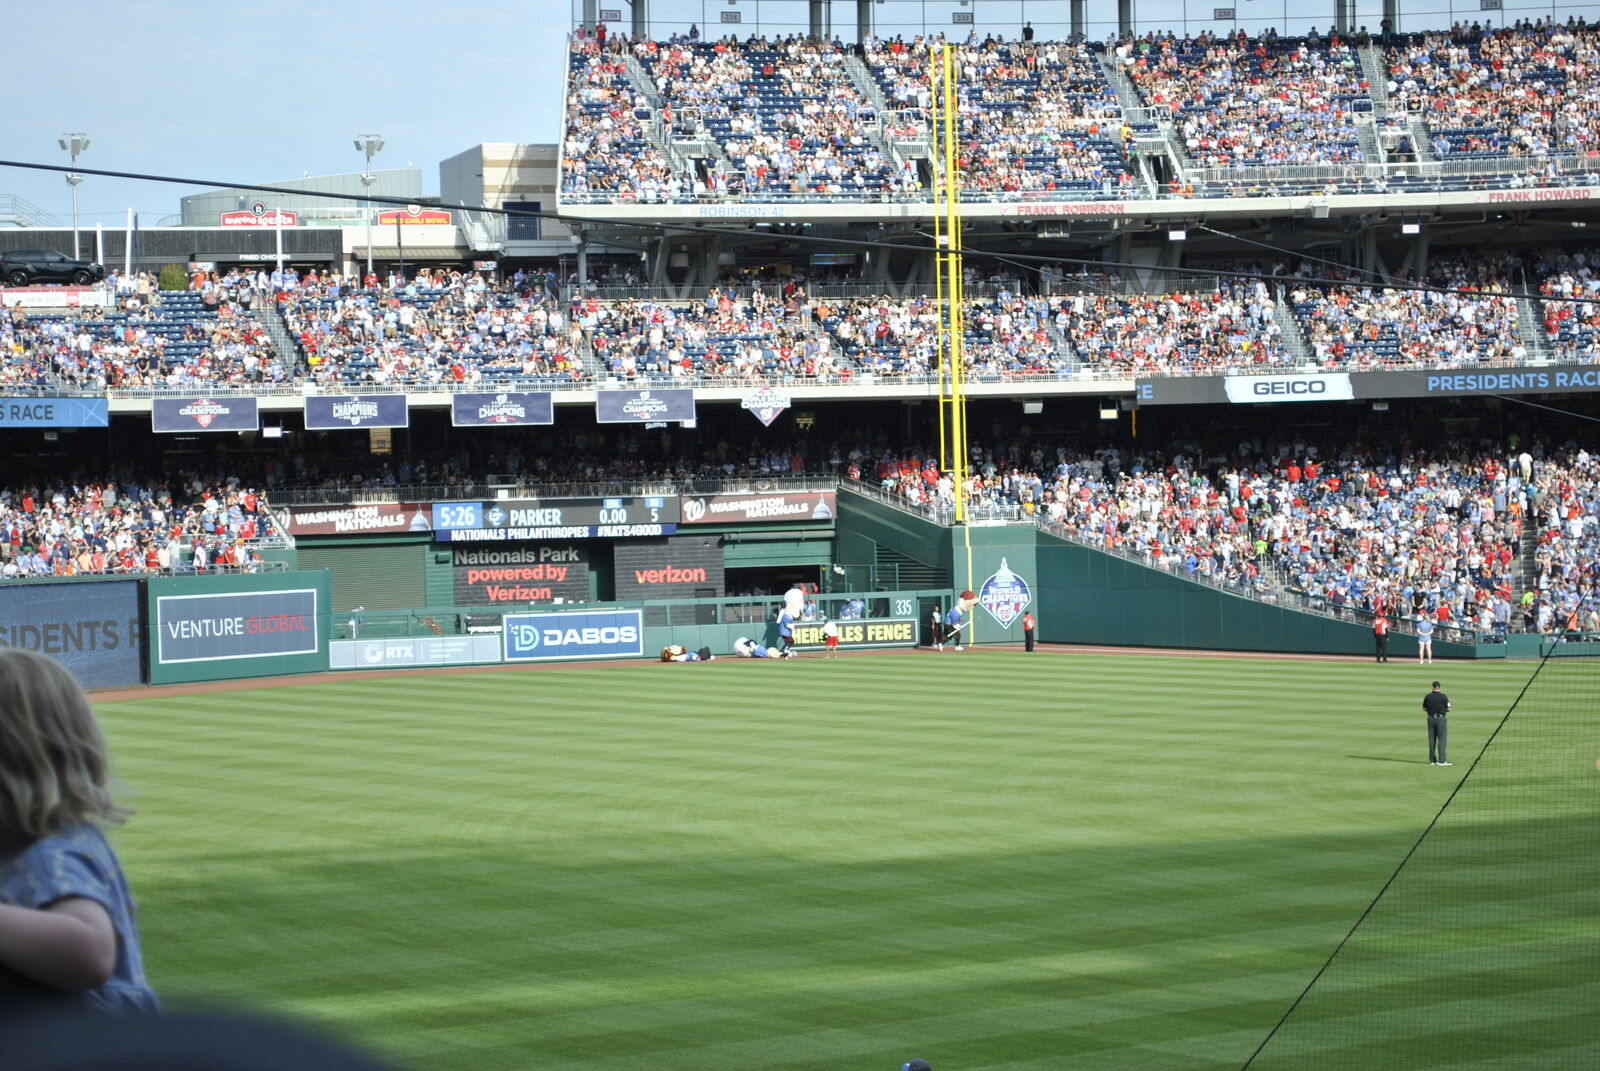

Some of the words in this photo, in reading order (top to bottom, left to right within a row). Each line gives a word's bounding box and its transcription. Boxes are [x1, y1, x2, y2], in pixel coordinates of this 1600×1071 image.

[1489, 191, 1530, 203] FRANK
[1534, 189, 1591, 200] HOWARD
[700, 207, 766, 217] ROBINSON
[1017, 205, 1057, 215] FRANK
[1063, 204, 1125, 214] ROBINSON
[1254, 381, 1326, 395] GEICO
[1428, 374, 1549, 391] PRESIDENTS
[10, 404, 54, 420] RACE
[179, 407, 230, 415] CHAMPIONS
[332, 404, 378, 418] CHAMPIONS
[478, 406, 525, 418] CHAMPIONS
[623, 404, 668, 413] CHAMPIONS
[741, 400, 792, 409] CHAMPIONS
[710, 497, 785, 513] WASHINGTON
[745, 503, 809, 518] NATIONALS
[295, 506, 378, 525] WASHINGTON
[335, 514, 405, 531] NATIONALS
[440, 506, 475, 527] 5:26
[509, 508, 562, 526] PARKER
[599, 509, 627, 524] 0.00
[650, 508, 659, 522] 5
[451, 528, 507, 541] NATIONALS
[507, 525, 590, 539] PHILANTHROPIES
[597, 524, 662, 538] #NATS4GOOD
[454, 548, 536, 565] Nationals
[540, 546, 580, 562] Park
[467, 564, 543, 584] powered
[545, 564, 567, 582] by
[635, 565, 706, 584] verizon
[486, 585, 552, 601] Verizon
[981, 593, 1029, 603] CHAMPIONS
[988, 586, 1021, 595] WORLD
[895, 599, 912, 616] 335
[168, 617, 244, 639] VENTURE
[246, 614, 309, 634] GLOBAL
[867, 623, 912, 641] FENCE
[543, 626, 638, 646] DABOS
[385, 646, 414, 659] RTX
